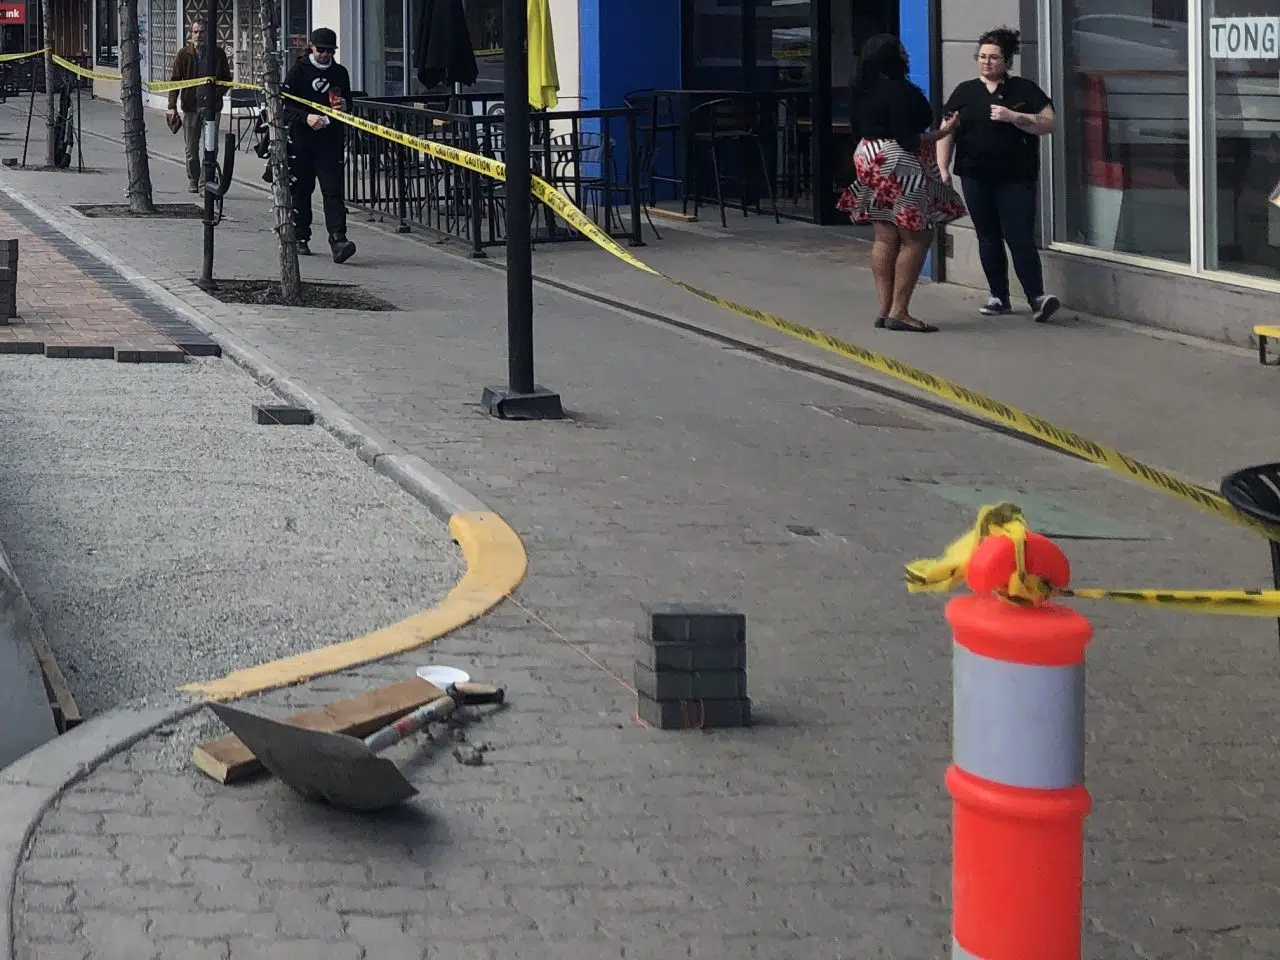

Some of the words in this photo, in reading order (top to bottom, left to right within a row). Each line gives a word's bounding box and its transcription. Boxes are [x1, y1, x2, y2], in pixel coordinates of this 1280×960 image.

[1211, 22, 1275, 53] TONG
[434, 144, 460, 161] CAUTION
[464, 154, 491, 172] CAUTION
